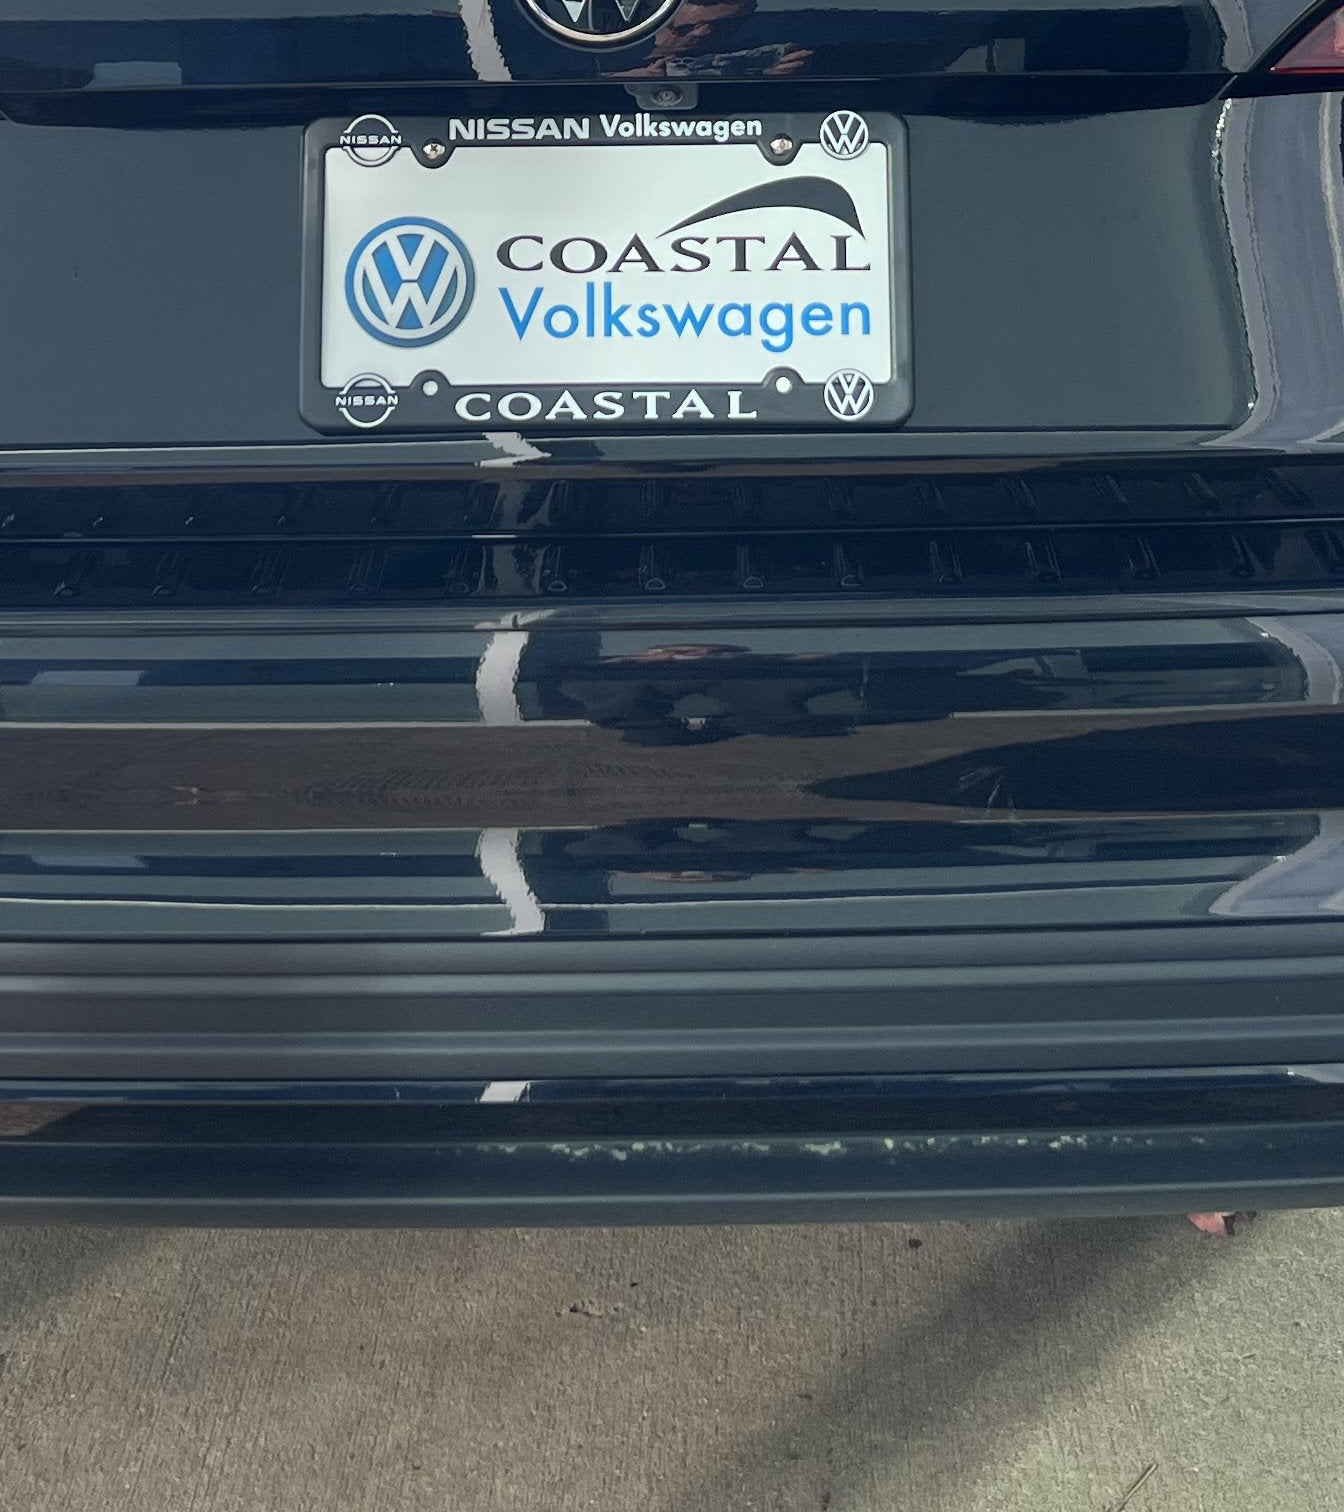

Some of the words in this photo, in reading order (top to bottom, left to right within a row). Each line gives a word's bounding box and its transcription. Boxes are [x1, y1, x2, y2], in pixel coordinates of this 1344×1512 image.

[339, 134, 402, 146] NISSAN
[449, 118, 590, 141] NISSAN
[600, 114, 763, 140] Volkswagen
[496, 232, 872, 273] COASTAL
[499, 281, 872, 353] Volkswagen
[335, 395, 399, 406] NISSAN
[455, 390, 758, 422] COASTAL
